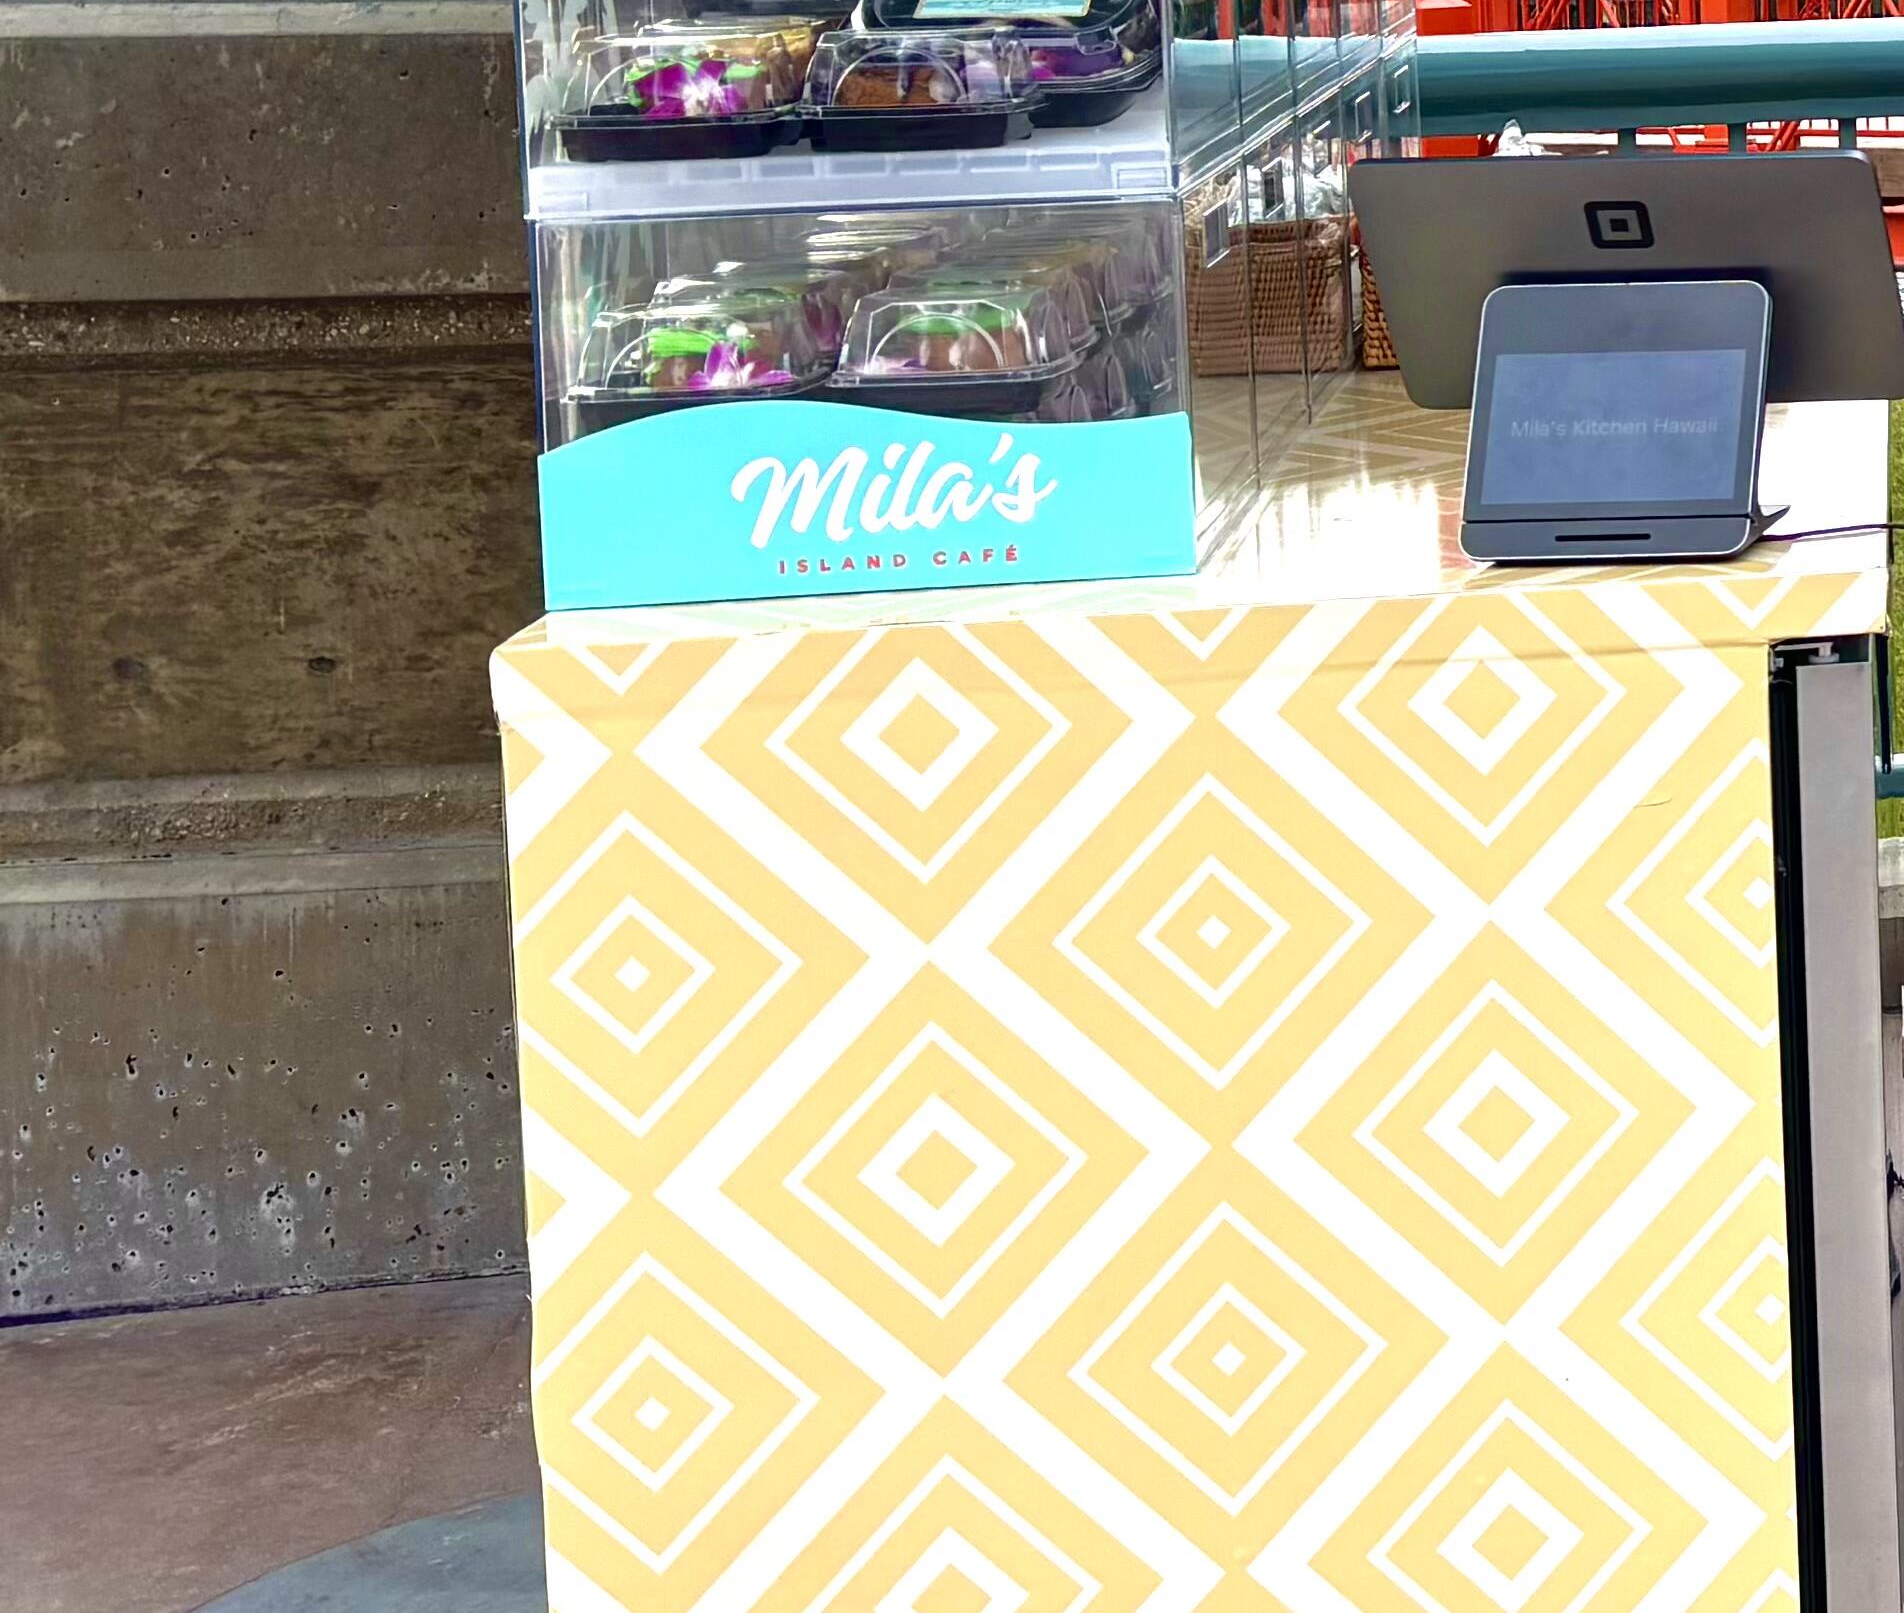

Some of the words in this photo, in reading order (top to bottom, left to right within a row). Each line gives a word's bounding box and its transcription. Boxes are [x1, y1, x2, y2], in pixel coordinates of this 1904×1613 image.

[1511, 420, 1566, 437] Mila's
[1573, 418, 1646, 436] Kitchen
[1653, 417, 1718, 434] Hawaii
[731, 431, 1058, 549] Mila's
[778, 553, 908, 576] ISLAND
[933, 544, 1018, 567] CAFÉ
